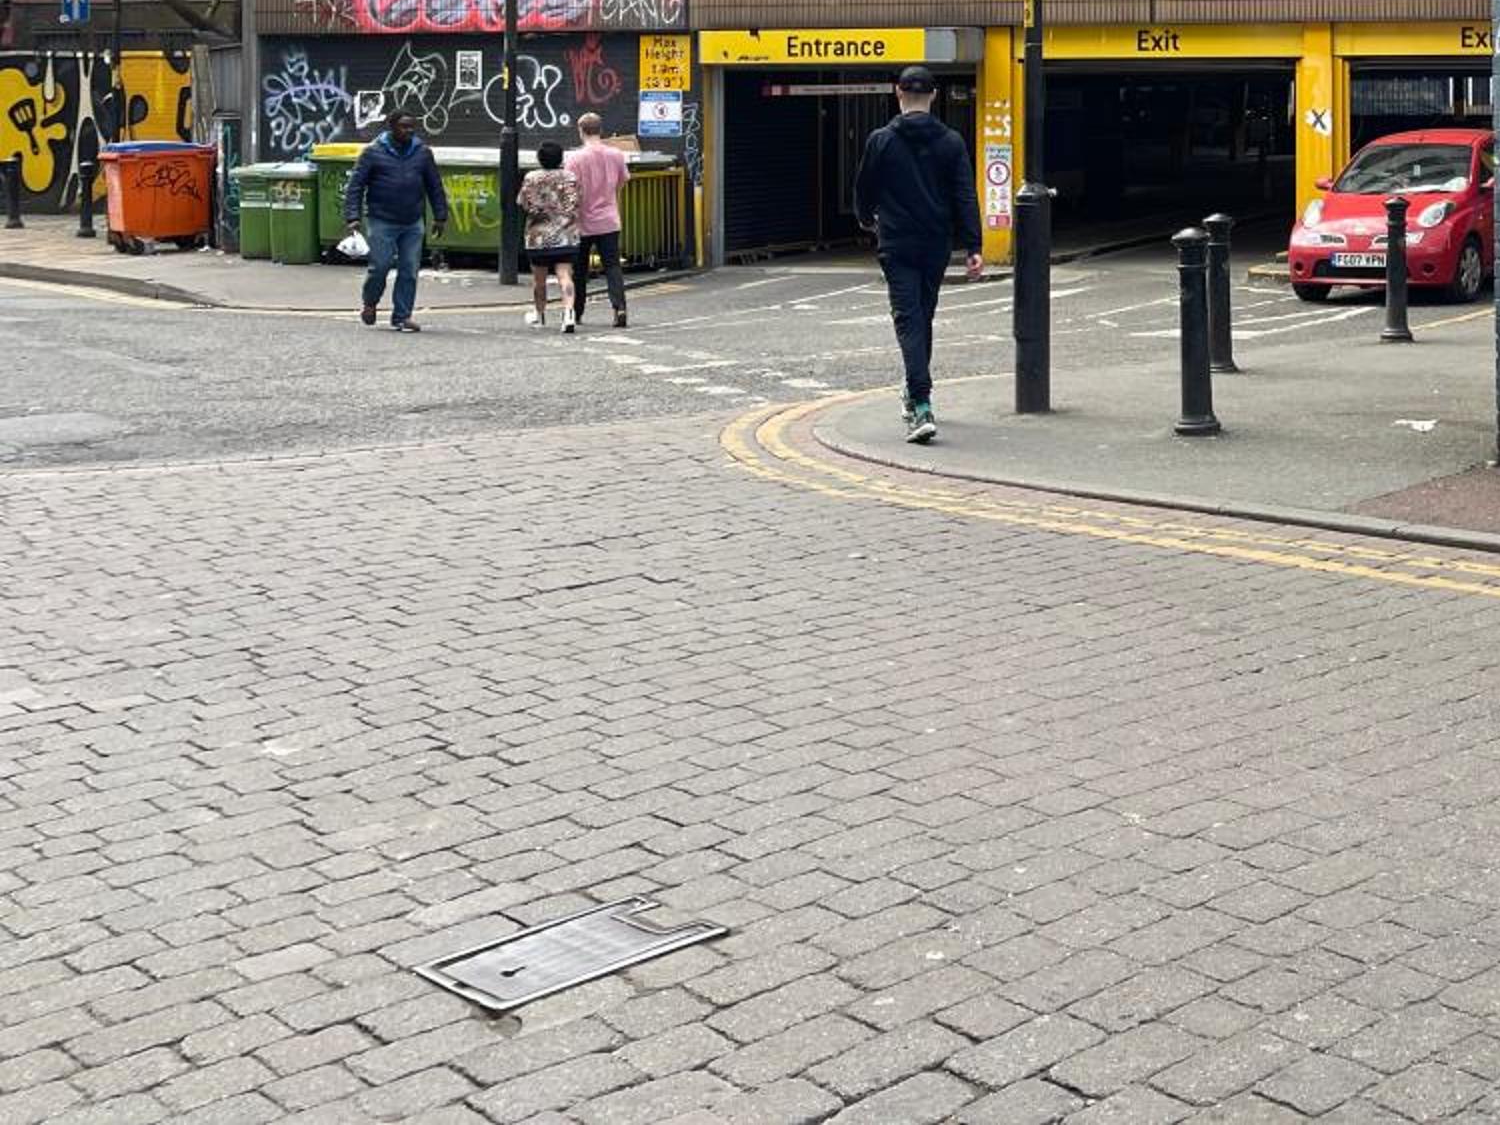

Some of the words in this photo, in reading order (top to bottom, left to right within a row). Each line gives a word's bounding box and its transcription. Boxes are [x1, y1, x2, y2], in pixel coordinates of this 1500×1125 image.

[787, 35, 885, 57] Entrance
[1137, 30, 1180, 52] Exit
[1461, 26, 1494, 48] Exi
